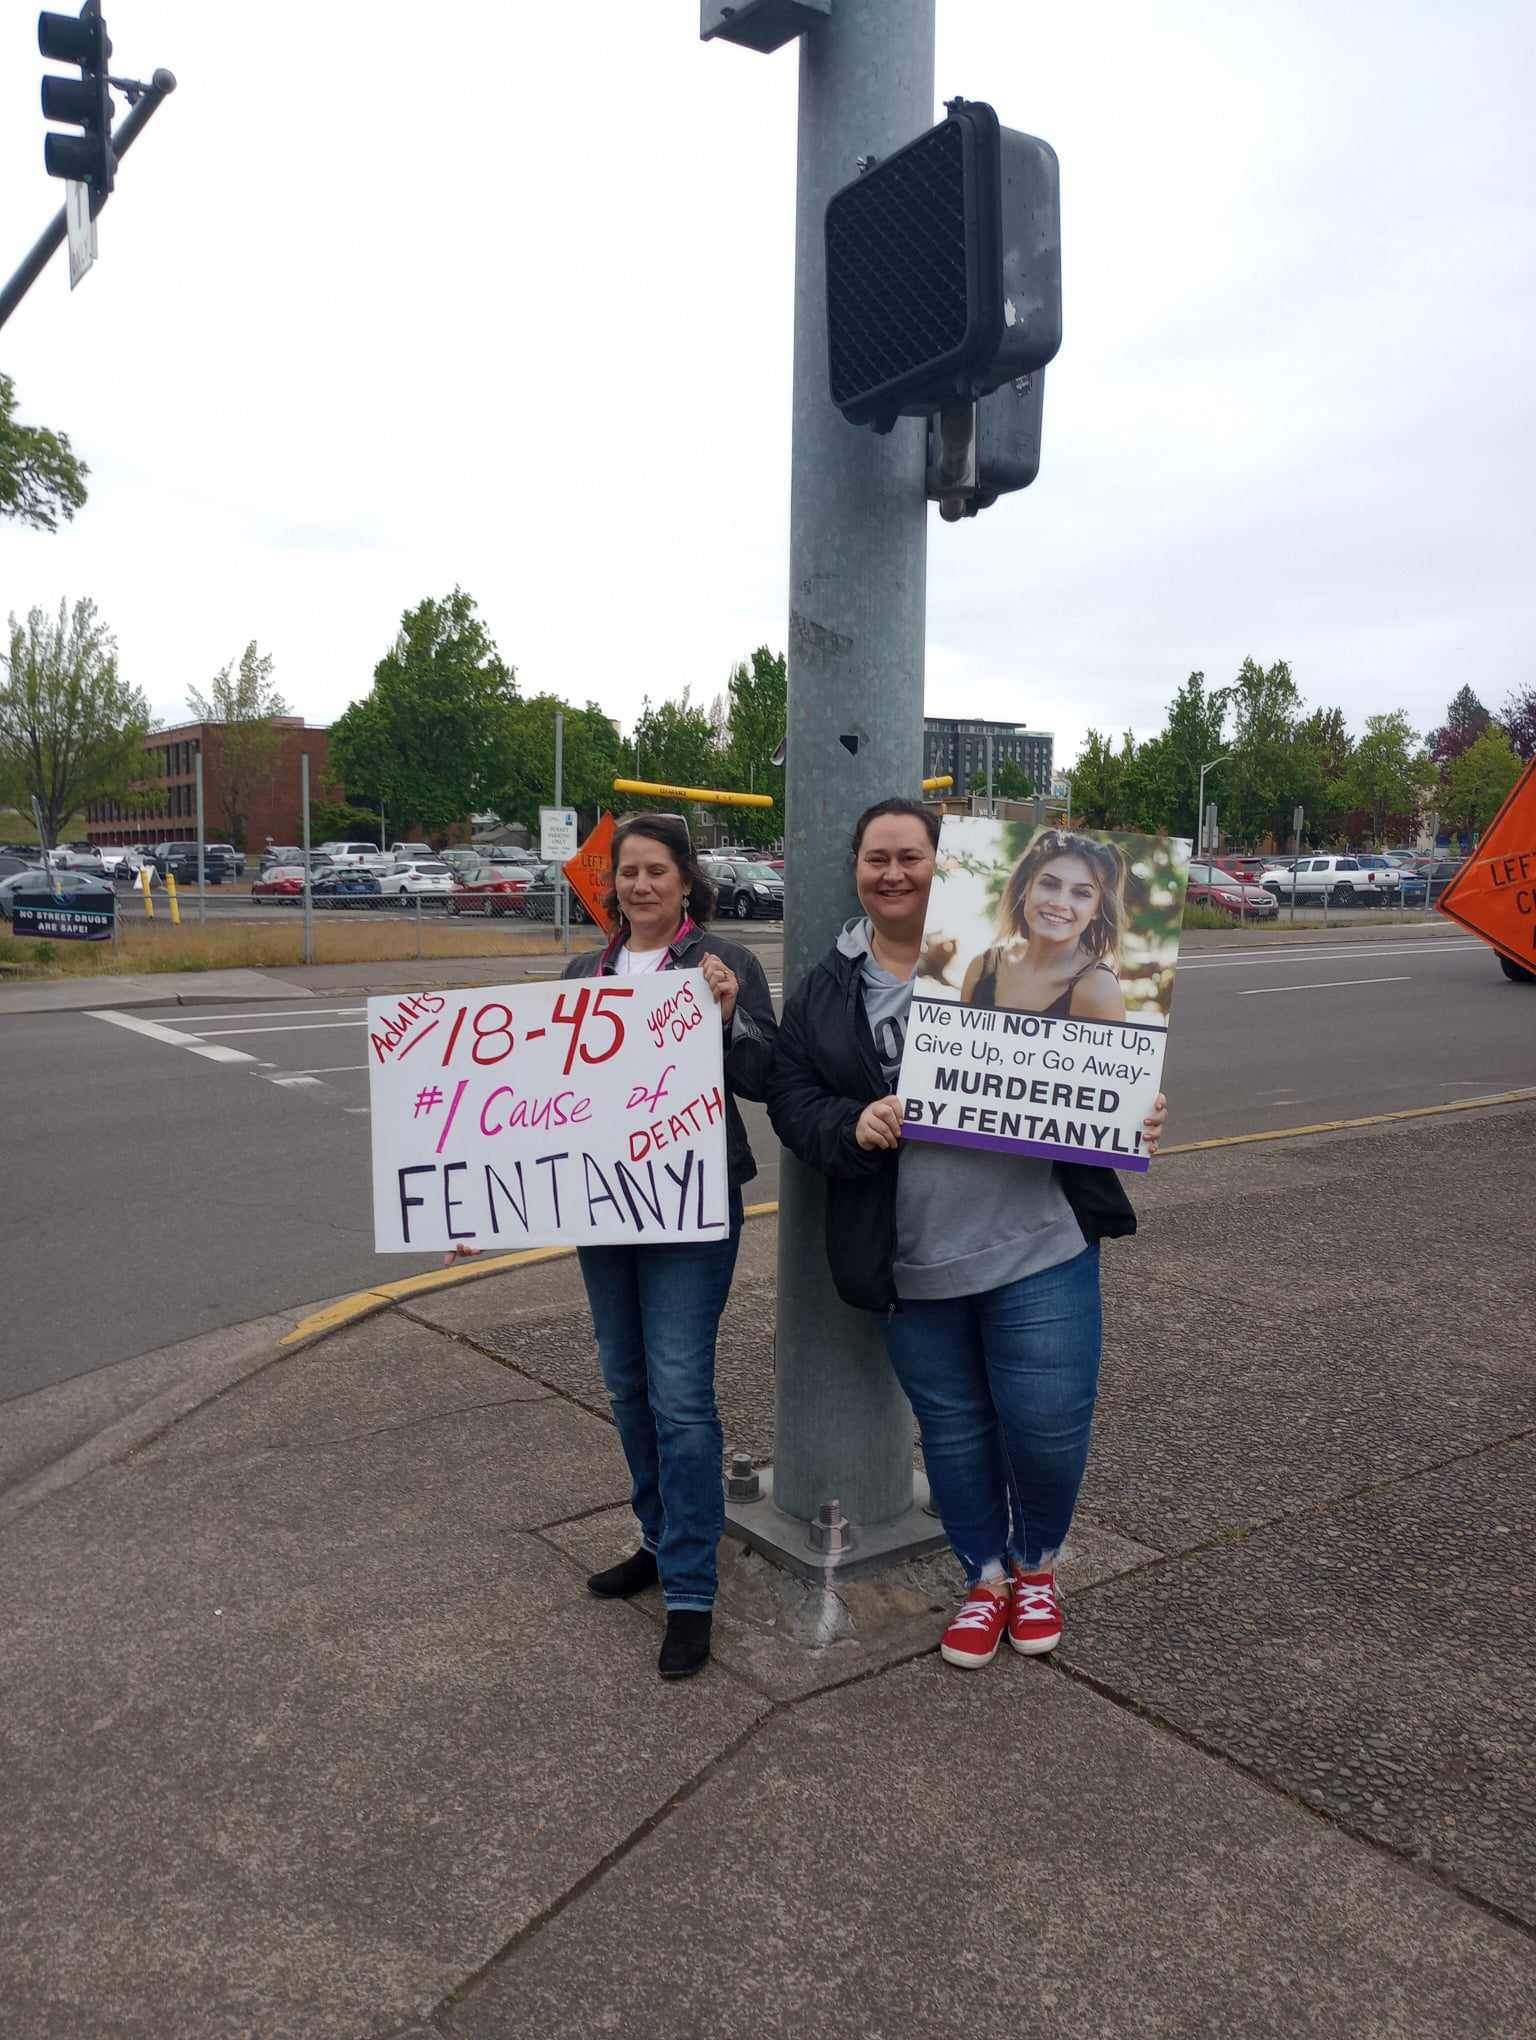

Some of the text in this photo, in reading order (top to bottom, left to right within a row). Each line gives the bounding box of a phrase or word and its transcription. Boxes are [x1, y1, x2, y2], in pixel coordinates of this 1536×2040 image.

[1490, 852, 1536, 886] LEF
[19, 910, 108, 925] NO STREET DRUGS
[38, 922, 88, 934] ARE SAFE!
[442, 988, 634, 1076] 18-45
[646, 980, 696, 1049] years
[918, 1004, 1155, 1056] We Will NOT Shut Up,
[914, 1033, 962, 1057] Give
[971, 1040, 1004, 1065] Up,
[1013, 1050, 1036, 1066] or
[1043, 1051, 1075, 1071] Go
[1082, 1055, 1151, 1085] Away-
[413, 1065, 676, 1154] #1 Cause of
[934, 1067, 1120, 1113] MURDERED
[629, 1087, 724, 1162] DEATH
[904, 1098, 1142, 1154] BY FENTANYL!
[397, 1150, 726, 1244] FENTANYL
